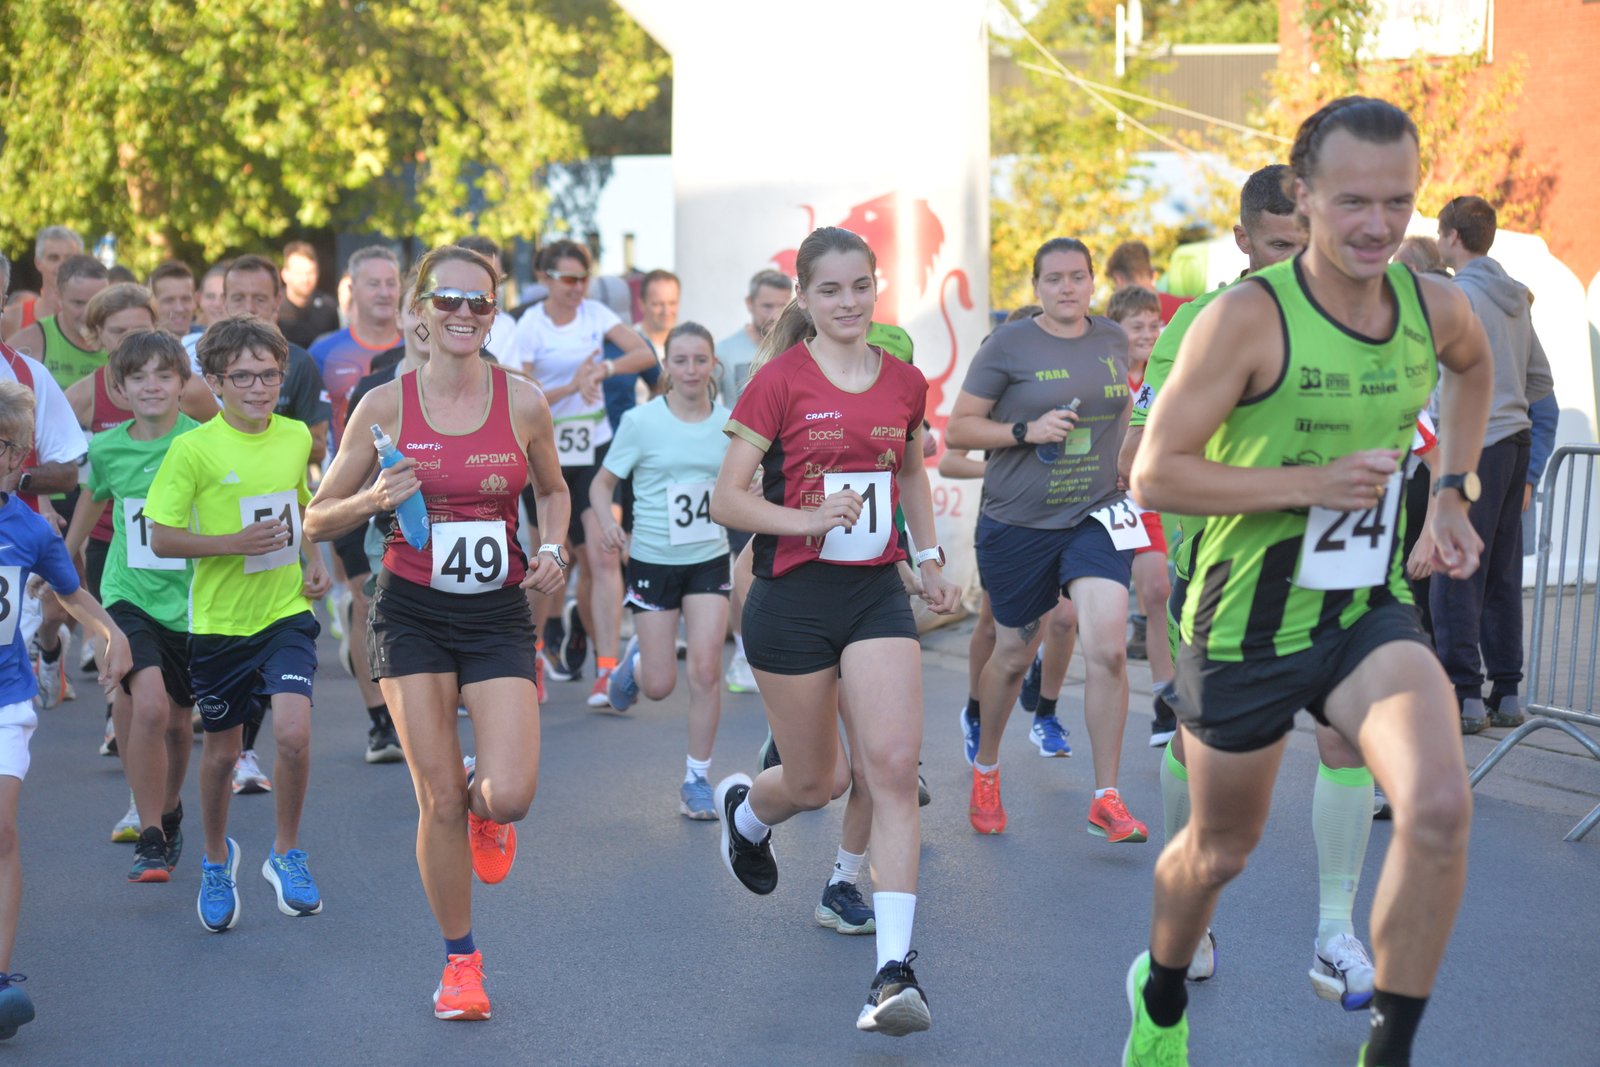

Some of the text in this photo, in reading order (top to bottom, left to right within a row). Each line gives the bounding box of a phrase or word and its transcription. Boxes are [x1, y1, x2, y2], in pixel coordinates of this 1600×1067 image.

[1035, 369, 1070, 381] TARA
[805, 412, 835, 420] CRAFT
[559, 428, 590, 453] 53
[674, 490, 712, 528] 34
[841, 482, 878, 535] 1
[934, 486, 963, 517] 92
[1095, 498, 1138, 531] 23
[131, 507, 148, 547] 1
[1313, 488, 1388, 553] 24
[441, 536, 502, 583] 49
[281, 674, 308, 684] CRAFT
